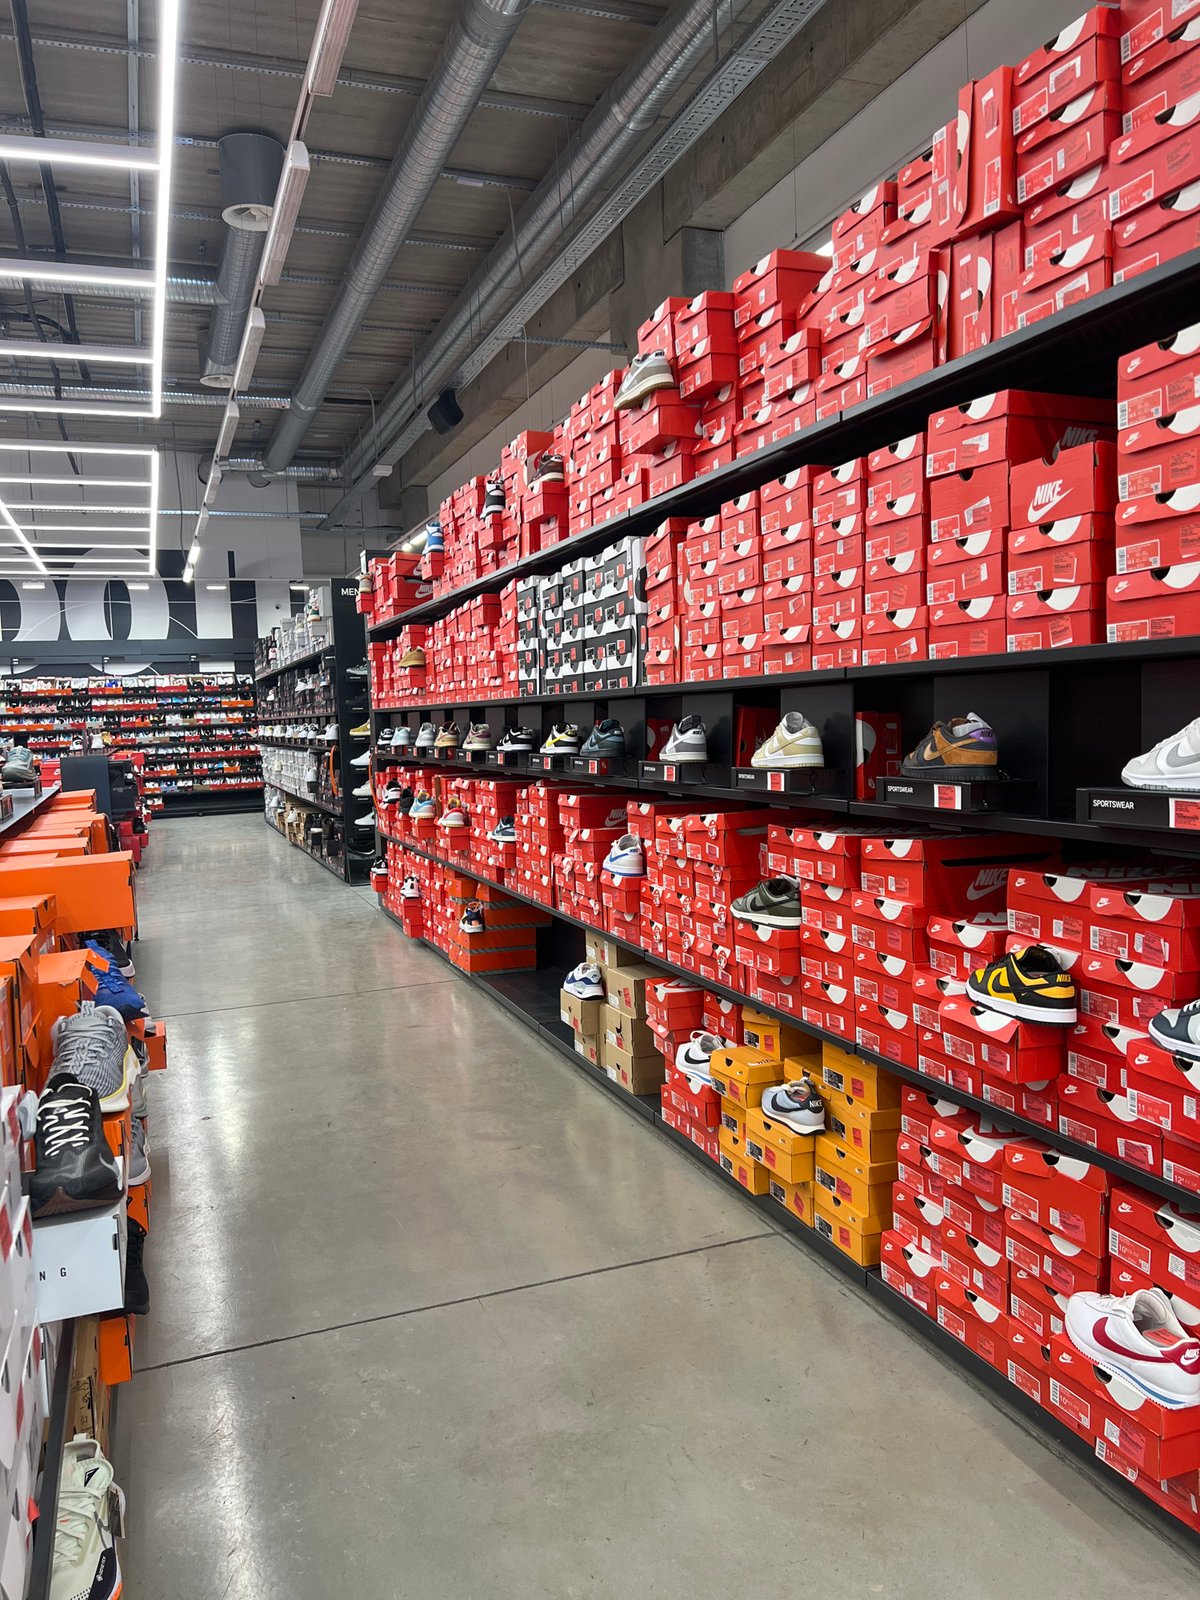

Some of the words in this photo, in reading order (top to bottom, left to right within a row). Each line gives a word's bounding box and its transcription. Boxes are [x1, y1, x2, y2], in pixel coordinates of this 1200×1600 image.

[1034, 480, 1062, 506] NIKE
[1092, 800, 1134, 810] SPORTSWEAR
[975, 868, 1008, 886] NIKE
[1056, 974, 1071, 982] NIKE
[810, 1100, 822, 1108] NIKE
